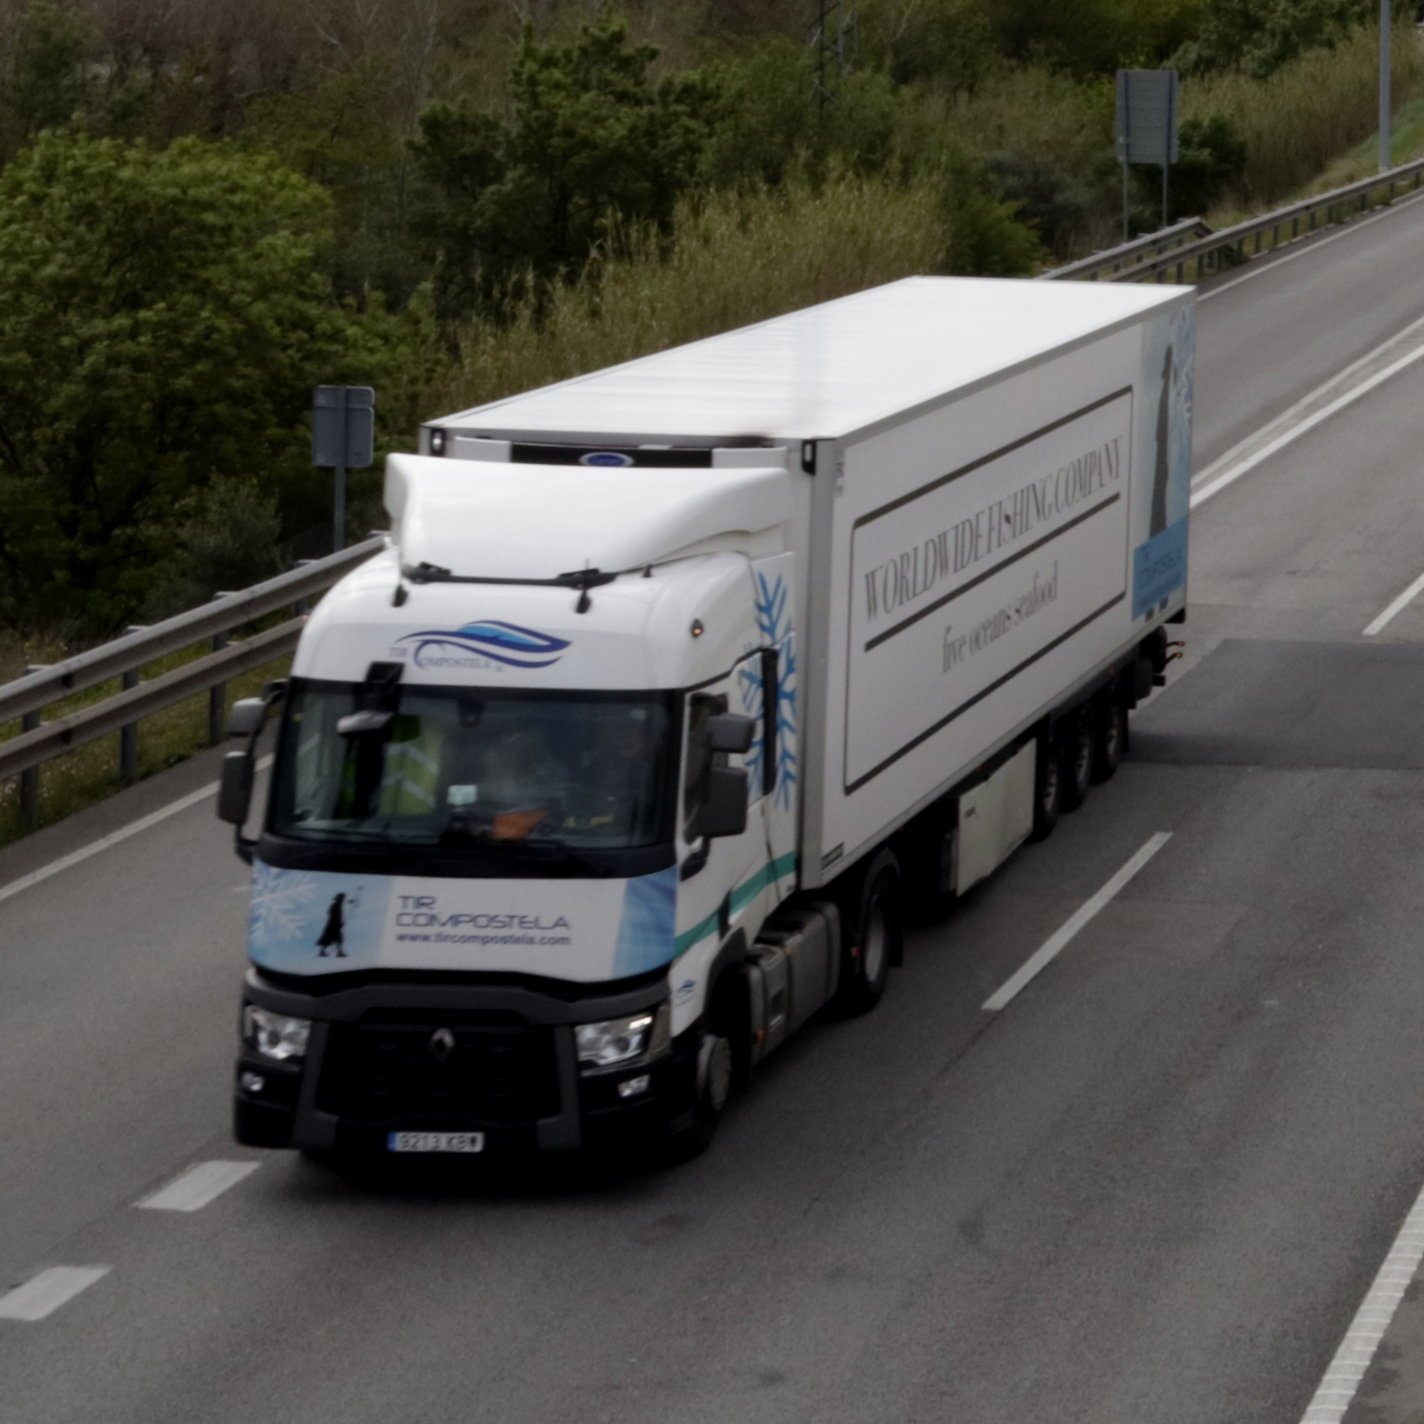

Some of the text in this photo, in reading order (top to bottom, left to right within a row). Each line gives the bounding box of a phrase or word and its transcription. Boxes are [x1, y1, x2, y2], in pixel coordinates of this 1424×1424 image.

[864, 436, 1123, 622] WORLDWIDE FISHING COMPANY
[942, 559, 1058, 673] five oceans seafood
[398, 895, 436, 910] TIR
[396, 912, 570, 930] COMPOSTELA
[396, 932, 571, 946] www.tircompostela.com
